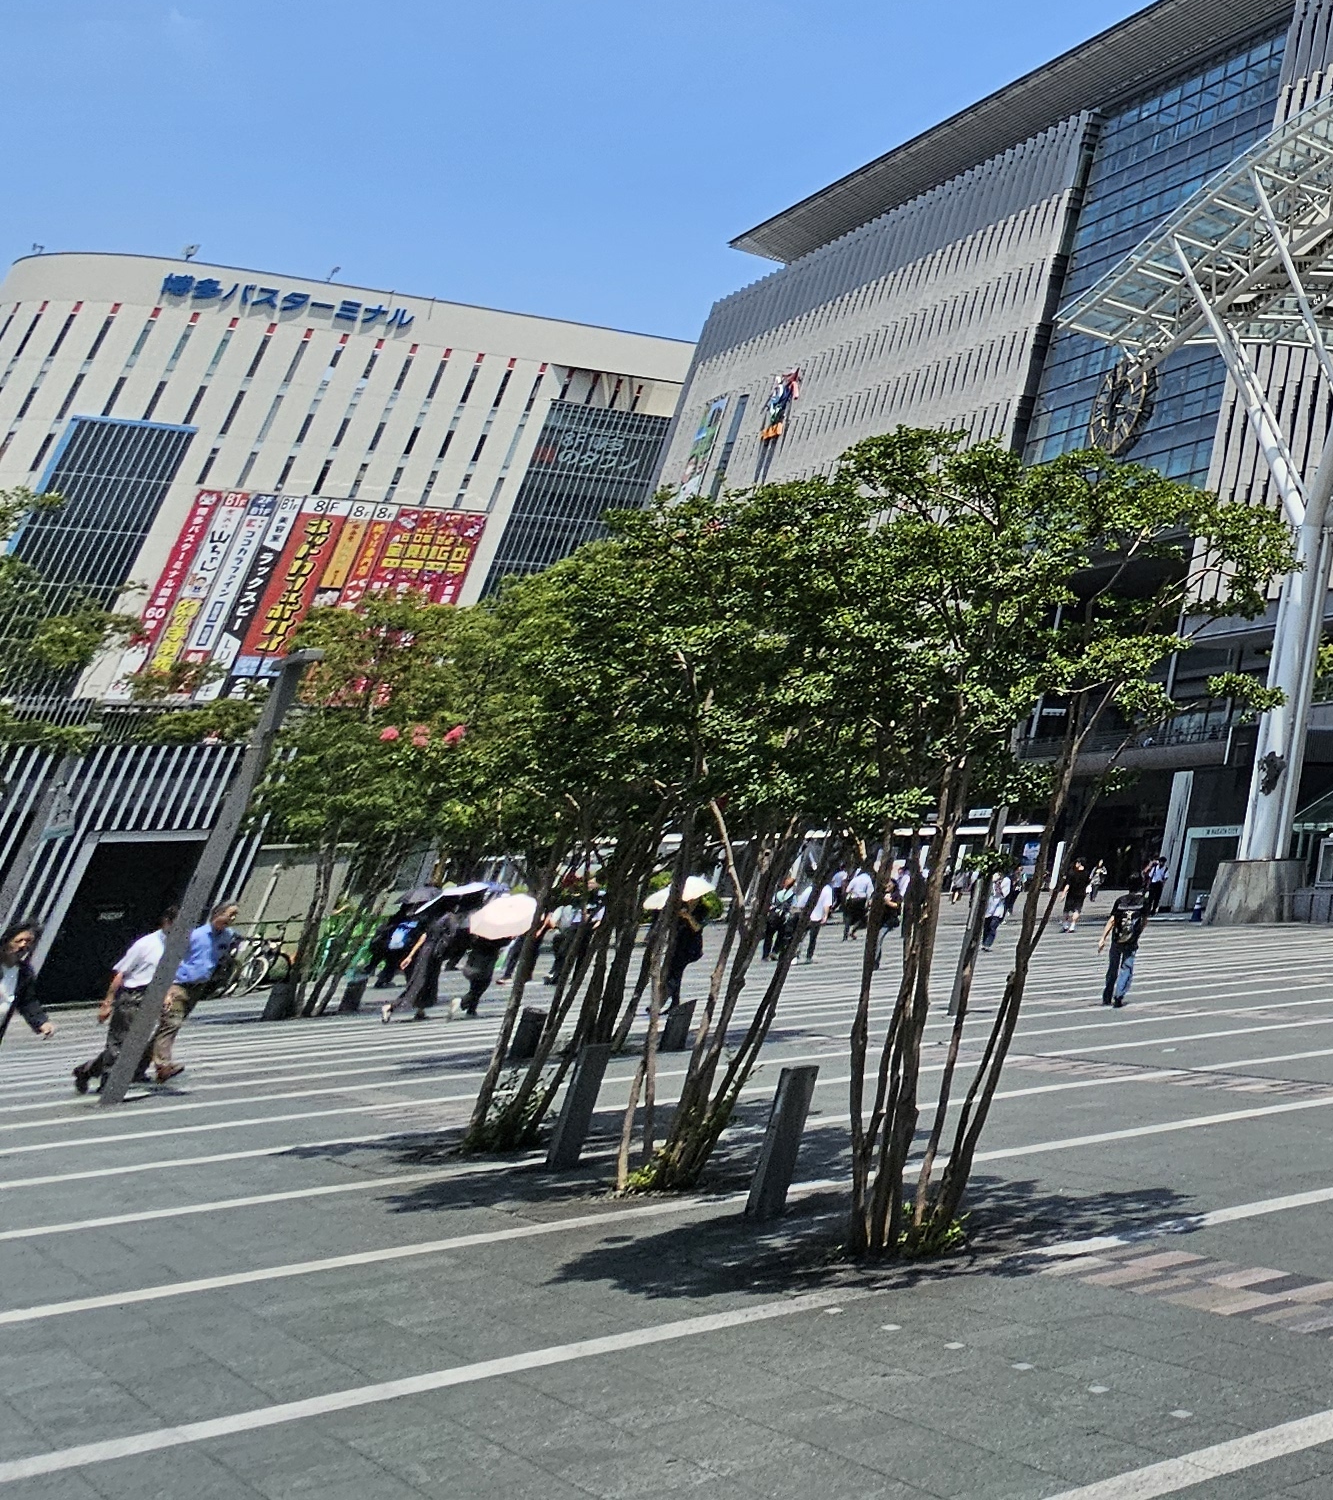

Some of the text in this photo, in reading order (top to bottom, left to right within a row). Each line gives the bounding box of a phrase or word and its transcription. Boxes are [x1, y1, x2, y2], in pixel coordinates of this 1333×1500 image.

[161, 272, 416, 330] 博多バスターミナル
[313, 500, 340, 513] 8F
[231, 551, 275, 631] ラックスビー
